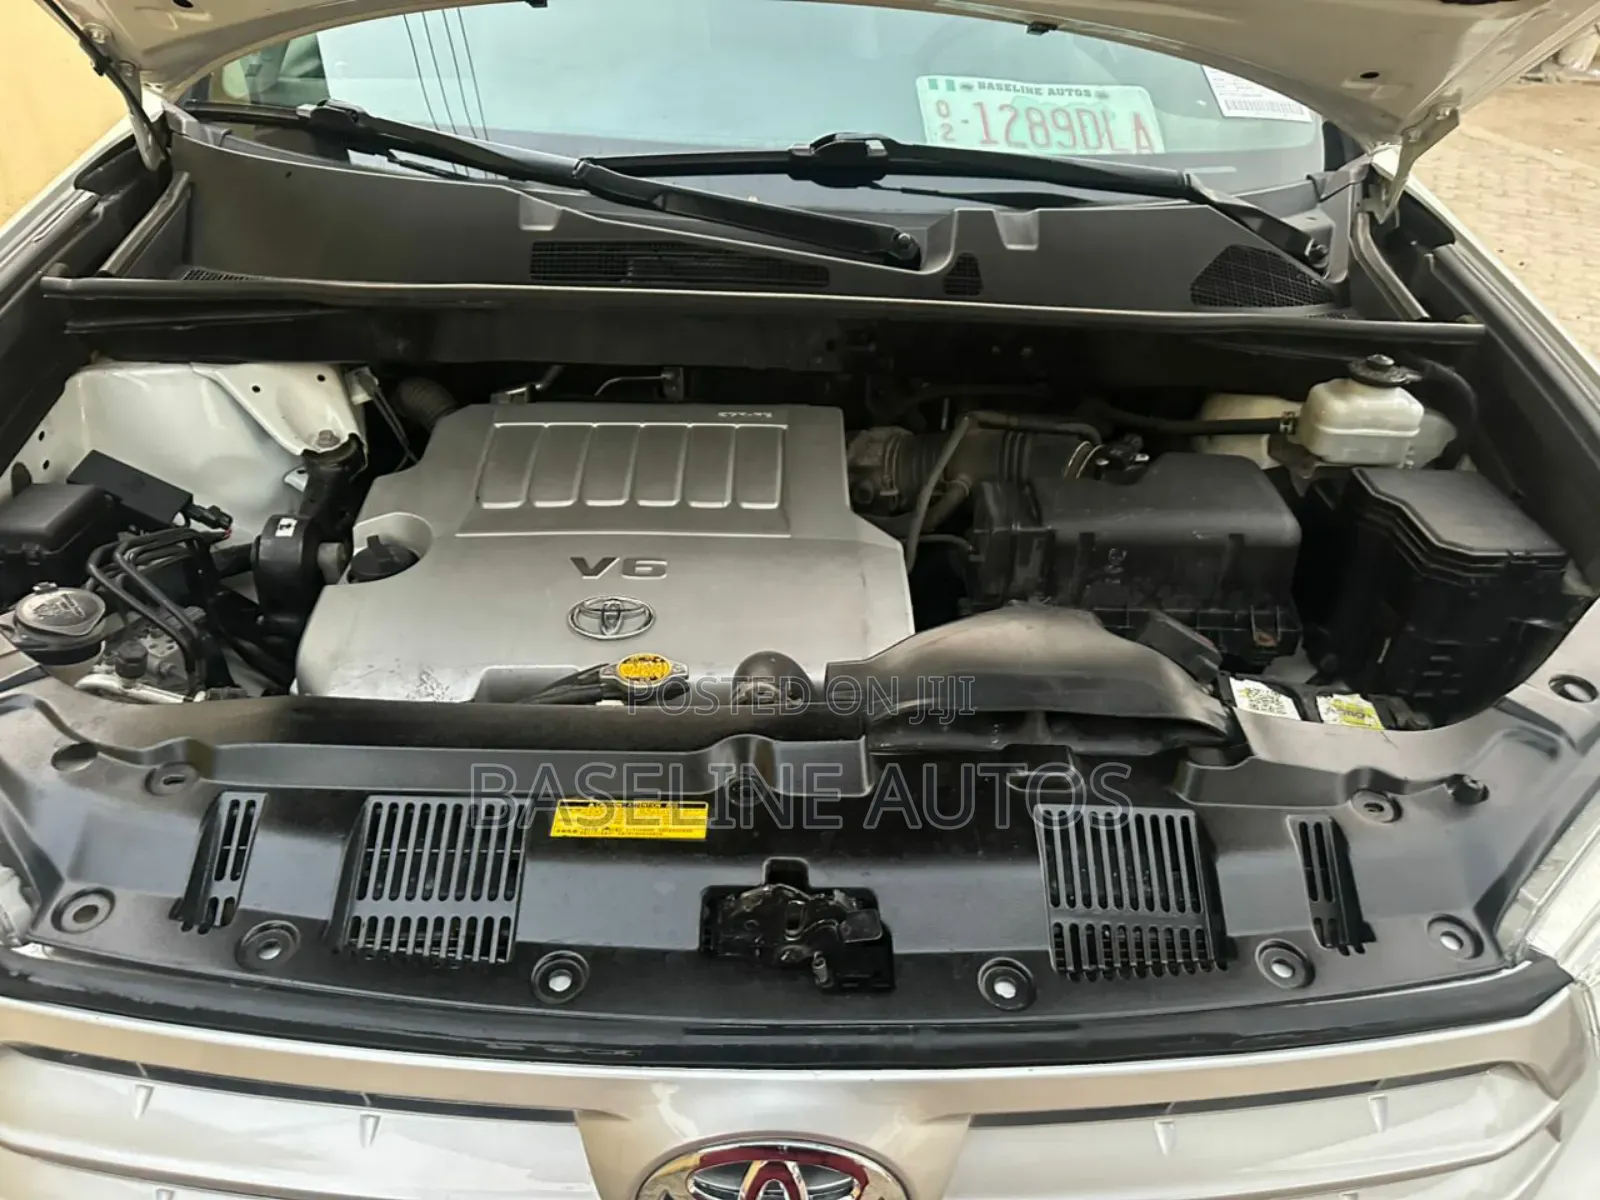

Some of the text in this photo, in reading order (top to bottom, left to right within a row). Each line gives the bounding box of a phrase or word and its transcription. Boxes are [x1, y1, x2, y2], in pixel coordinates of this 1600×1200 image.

[977, 81, 1092, 98] BASELINE AUTOS
[570, 556, 668, 580] V6
